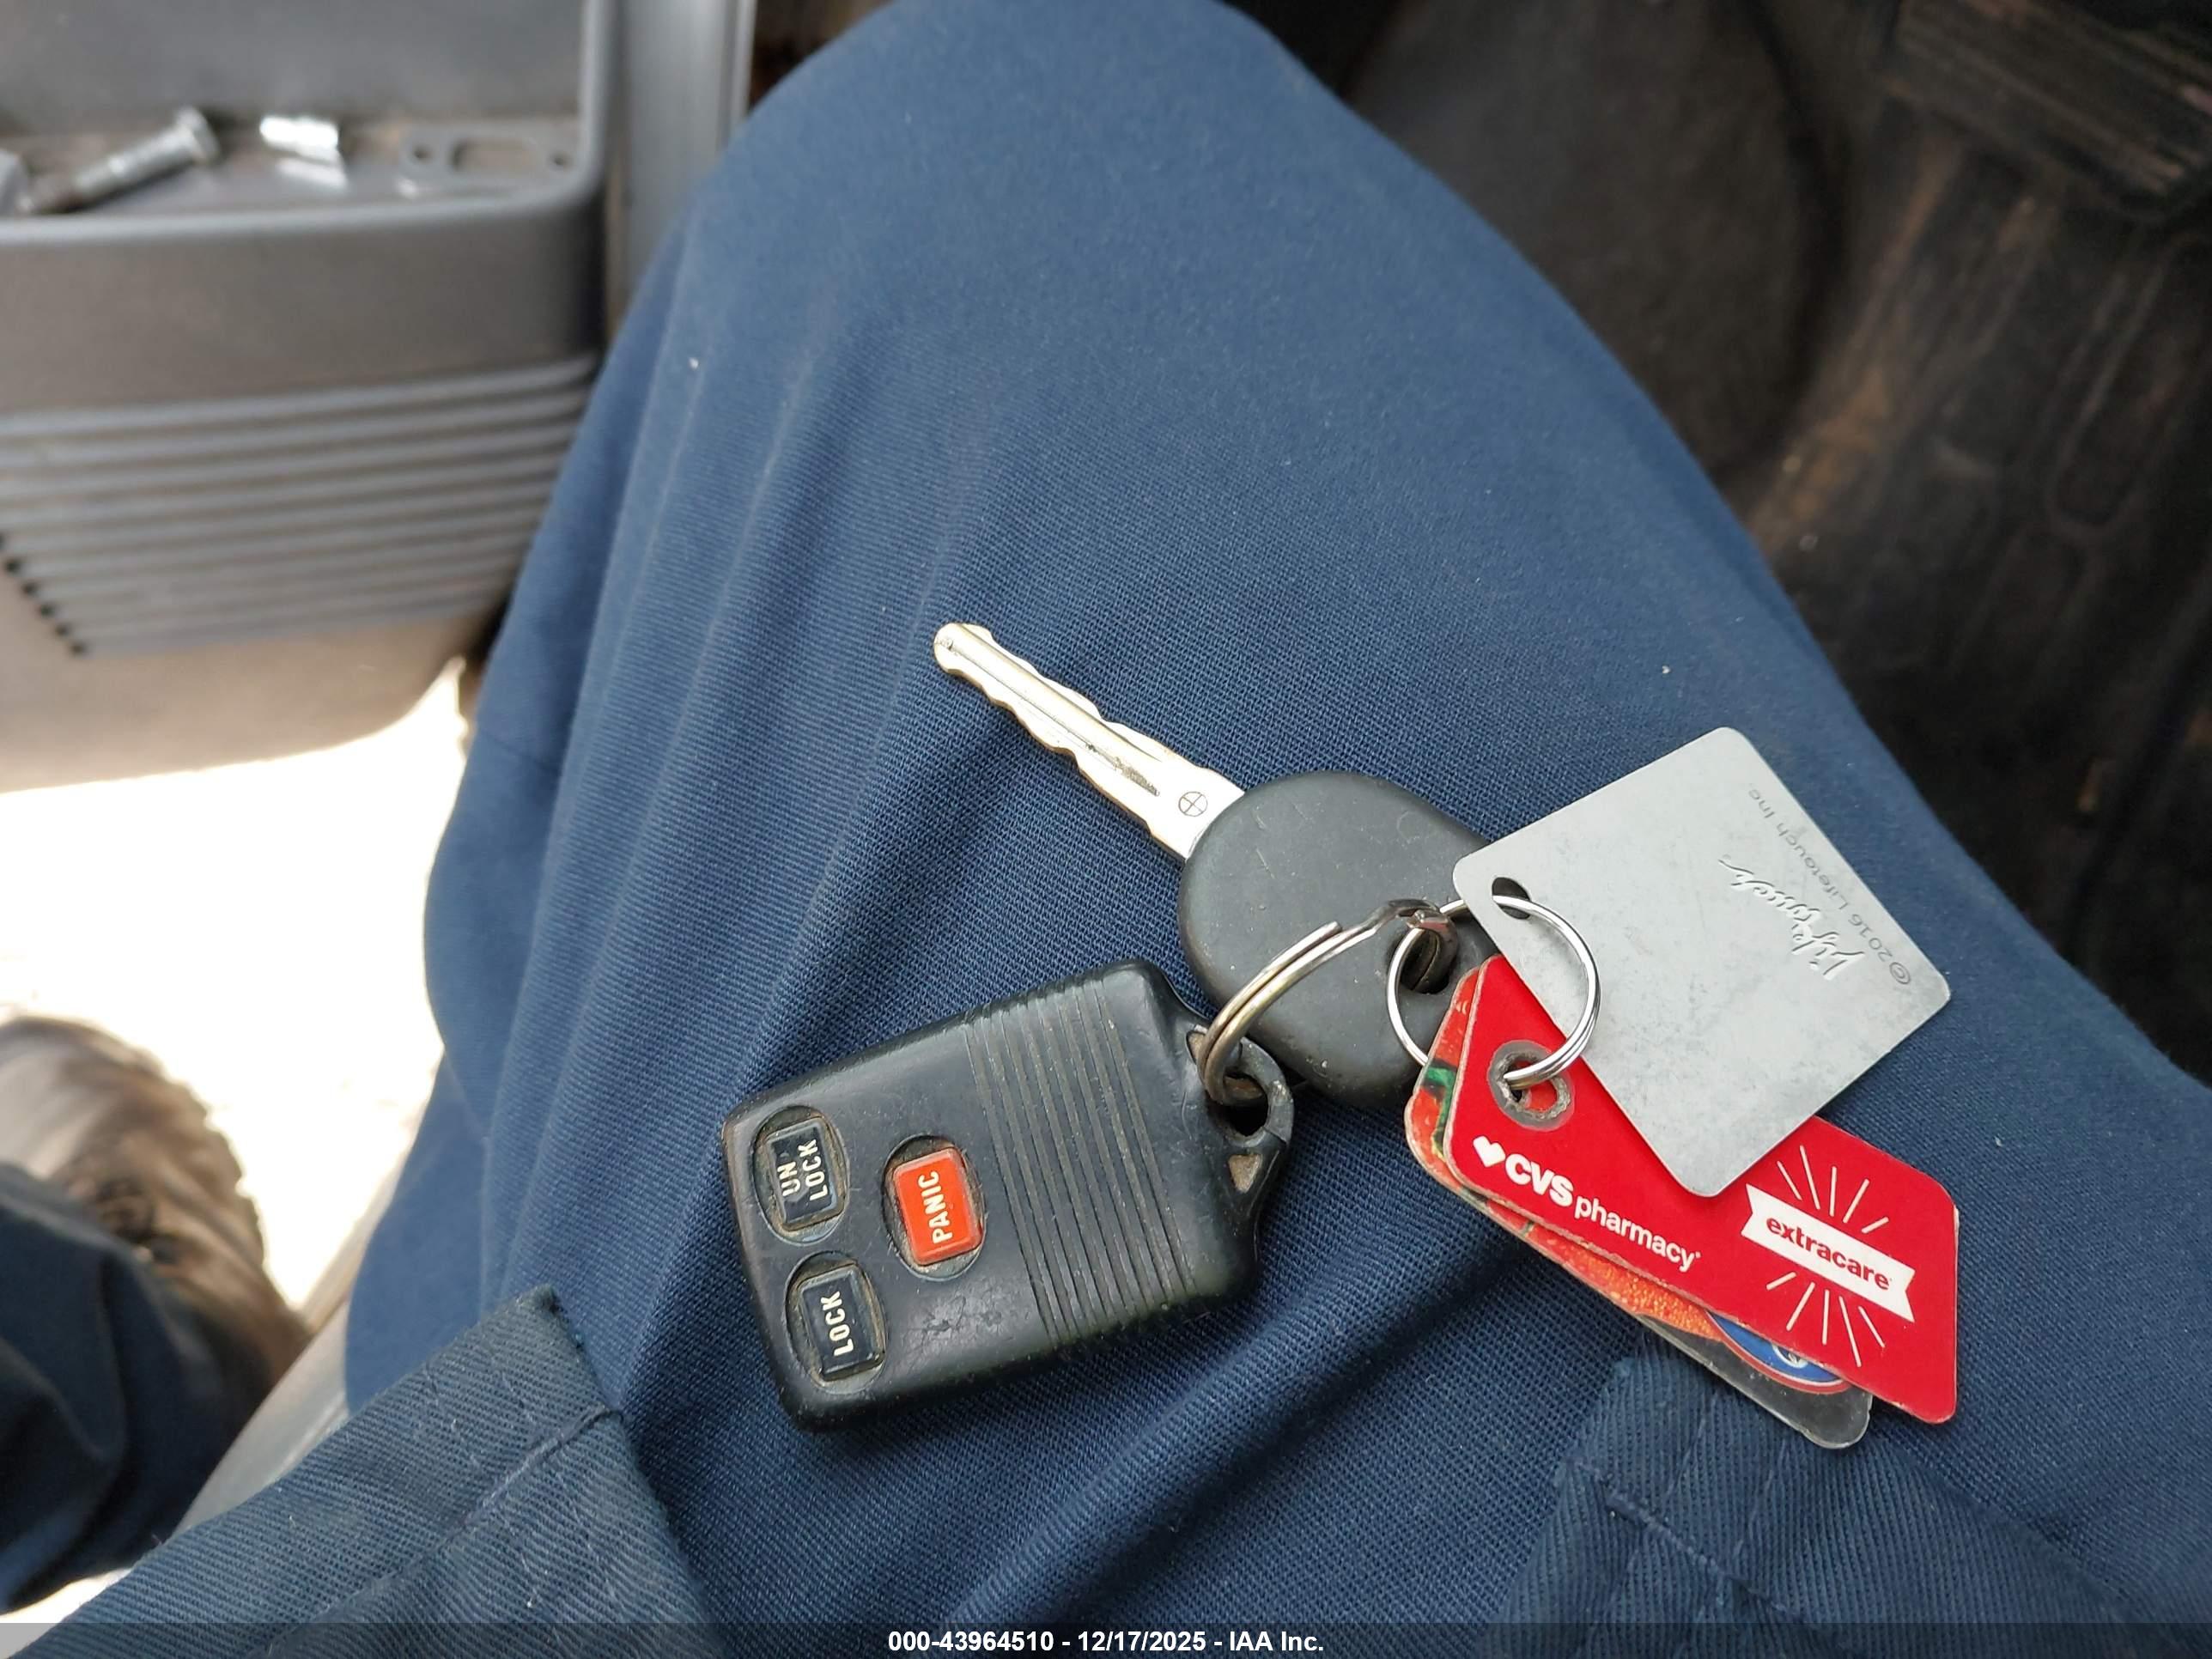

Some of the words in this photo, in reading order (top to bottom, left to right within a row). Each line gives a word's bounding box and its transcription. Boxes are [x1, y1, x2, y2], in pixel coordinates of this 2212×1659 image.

[1776, 822, 1849, 910] Lifetouch
[776, 1160, 801, 1197] UN
[798, 1138, 829, 1201] LOCK
[918, 1170, 953, 1243] PANIC
[1504, 1152, 1574, 1207] CVS
[1574, 1192, 1698, 1273] pharmacy
[1765, 1214, 1891, 1291] extracare
[819, 1291, 855, 1357] LOCK
